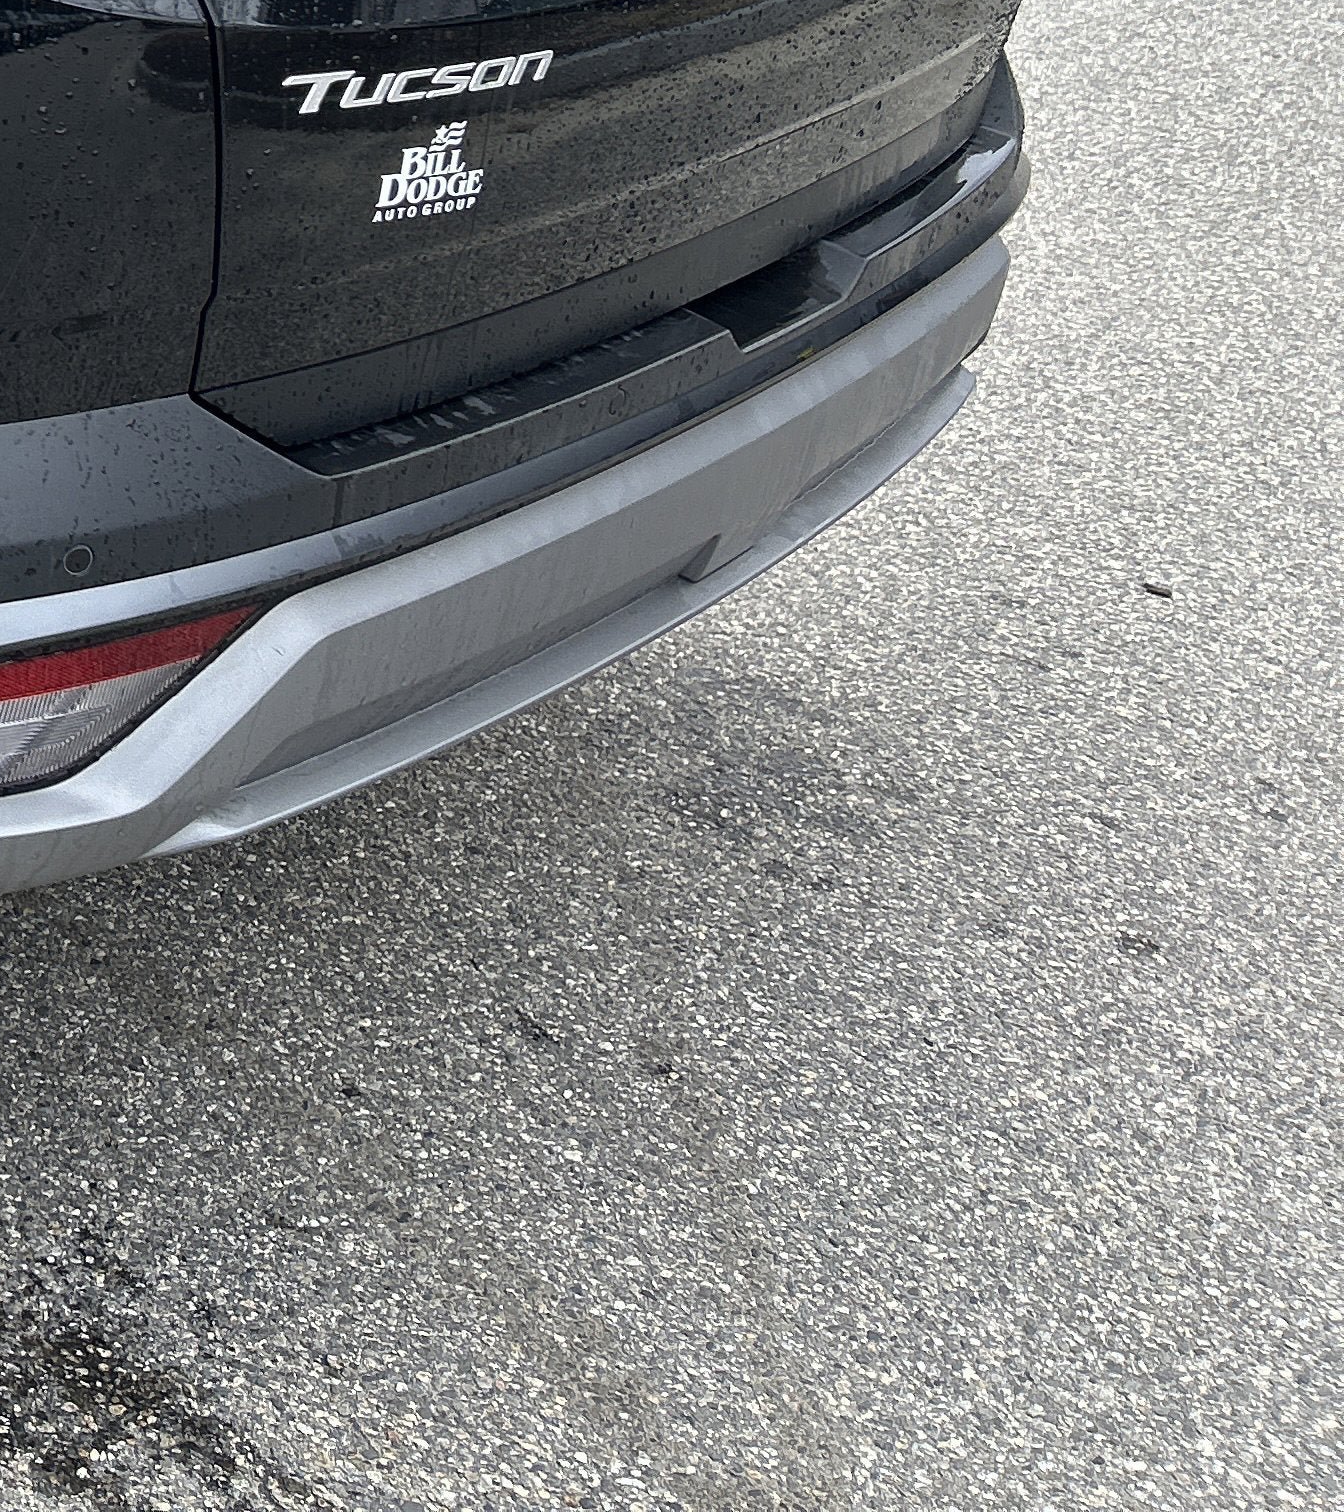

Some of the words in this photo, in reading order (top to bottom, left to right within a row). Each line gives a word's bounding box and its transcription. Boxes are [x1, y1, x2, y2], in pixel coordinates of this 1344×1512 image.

[400, 146, 466, 180] BILL
[375, 169, 484, 208] DODGE
[372, 205, 418, 223] AUTO
[421, 196, 476, 216] GROUP
